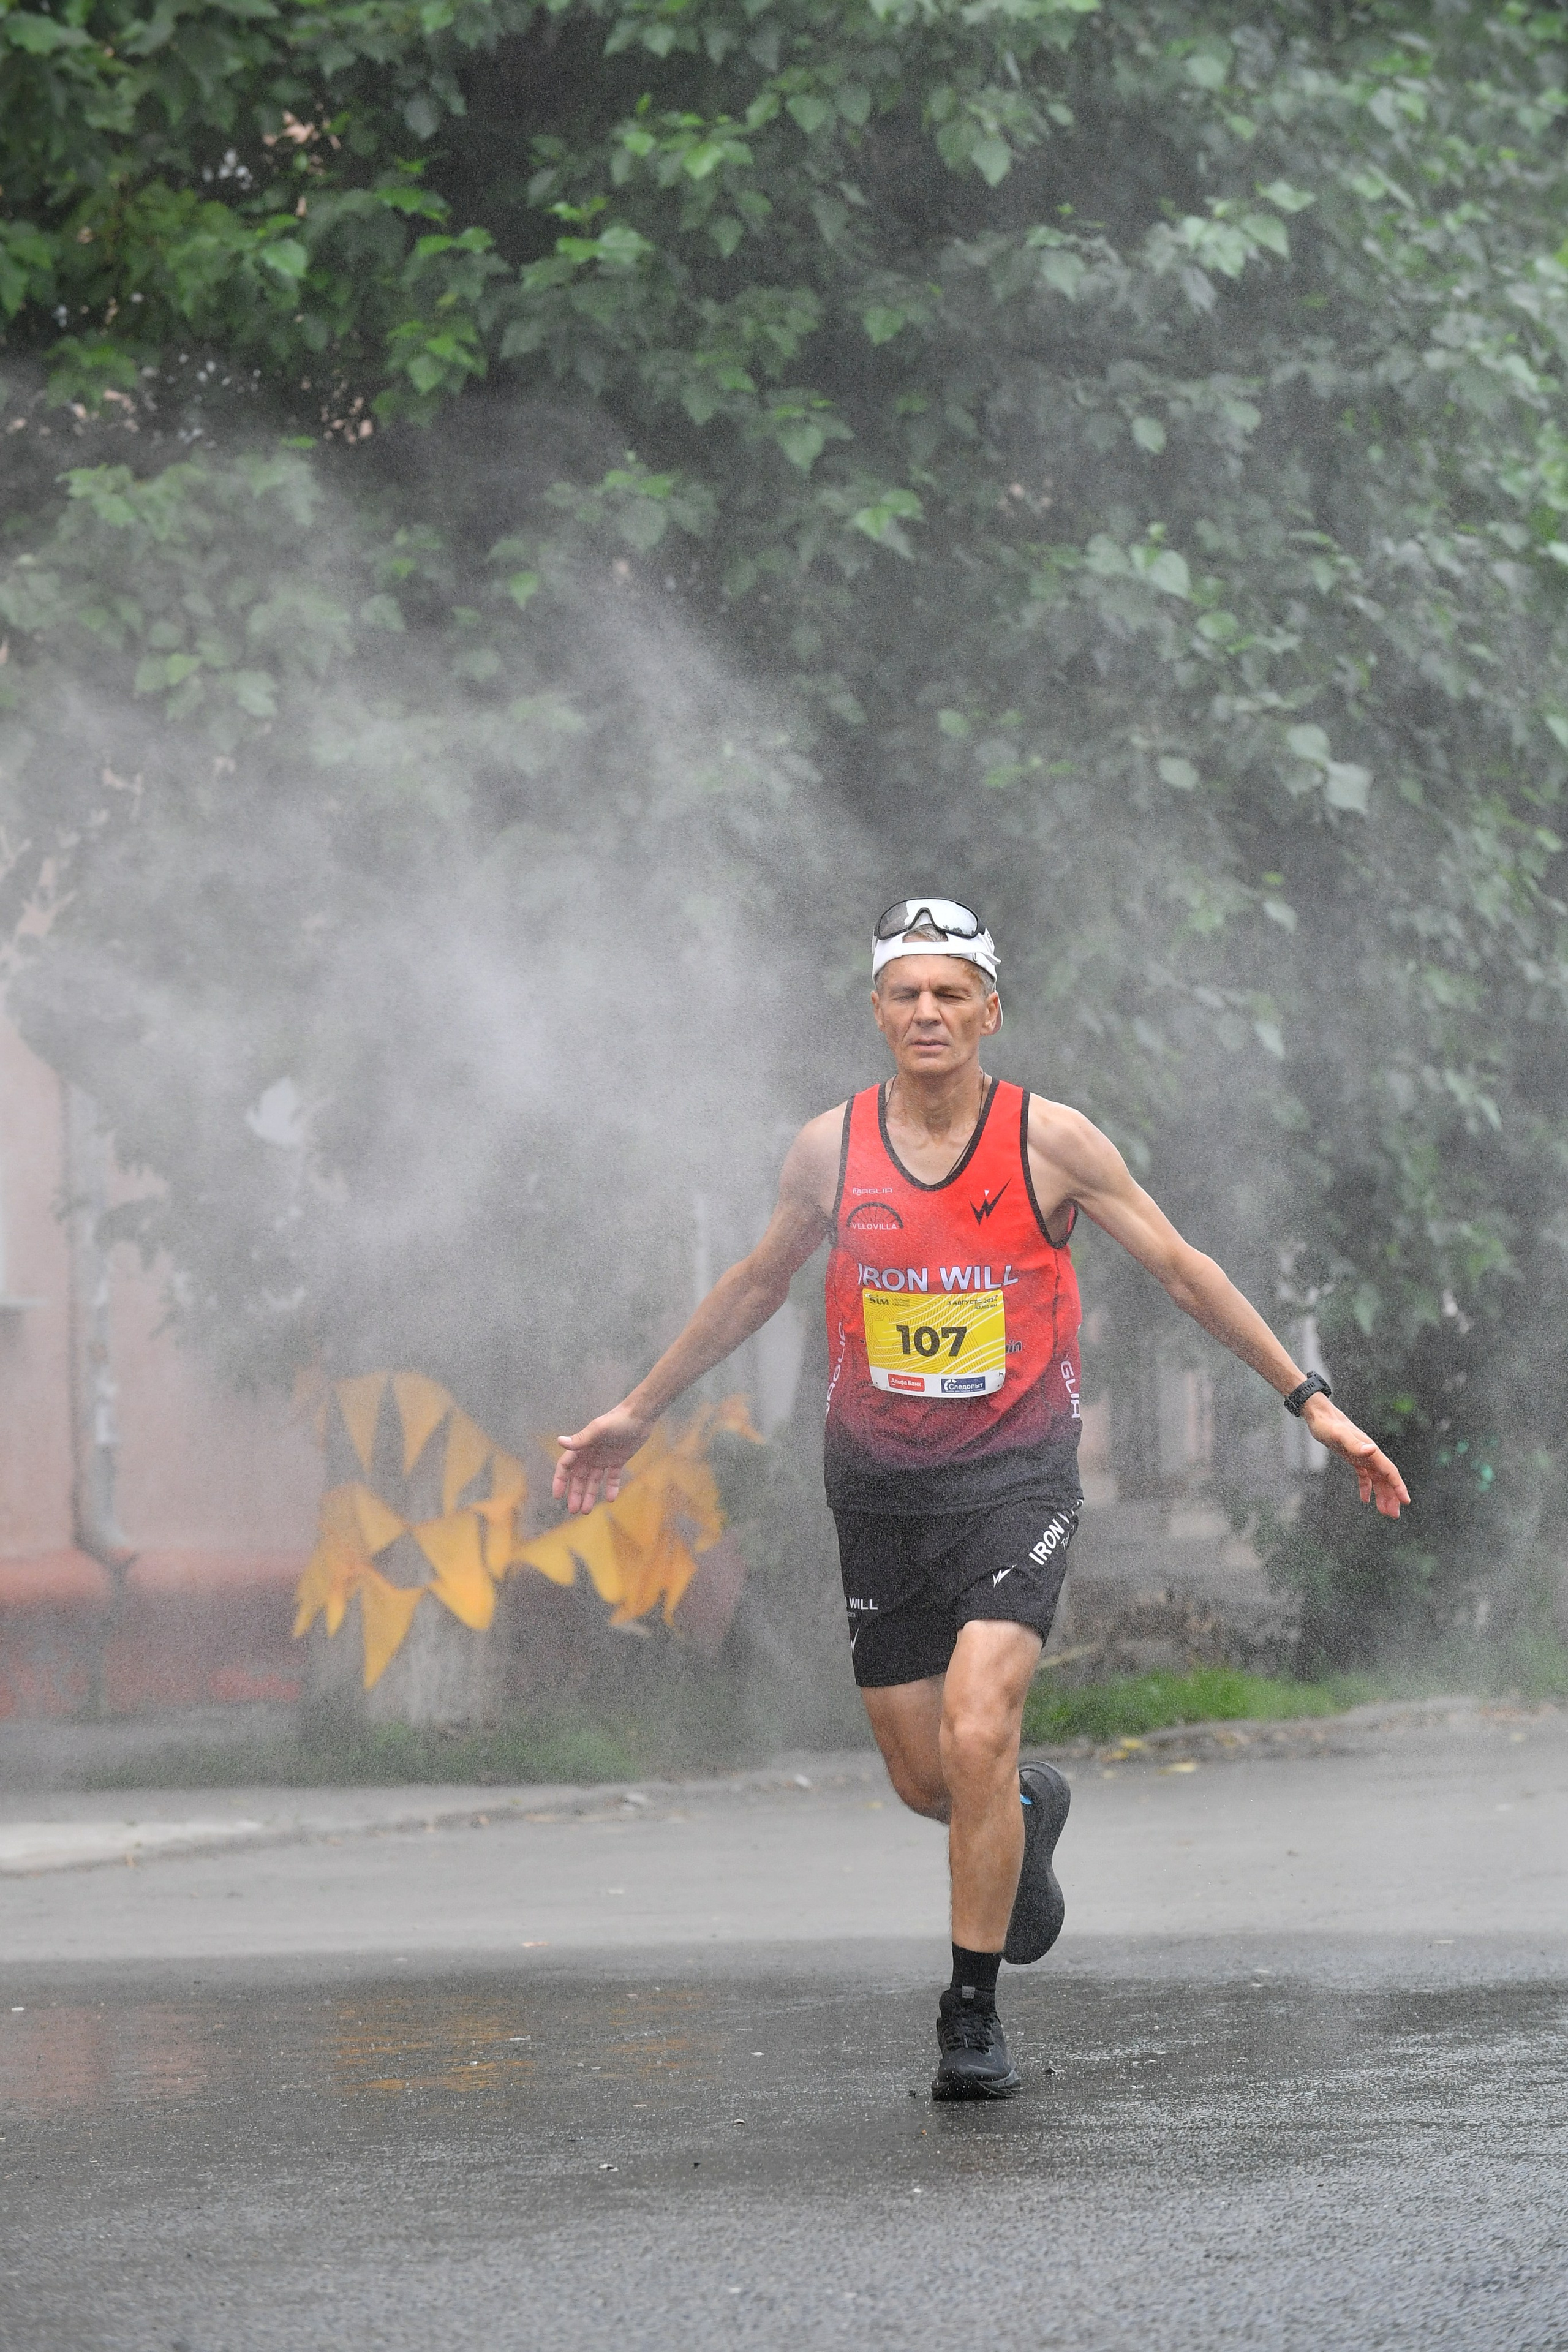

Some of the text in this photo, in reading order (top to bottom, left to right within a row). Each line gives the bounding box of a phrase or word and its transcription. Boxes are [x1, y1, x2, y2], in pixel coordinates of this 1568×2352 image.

[852, 1187, 893, 1196] MAGLIA
[858, 1262, 1019, 1292] IRON WILL
[895, 1324, 967, 1357] 107
[891, 1378, 908, 1386] Альфа
[1028, 1518, 1065, 1566] IRON
[849, 1597, 878, 1610] WILL
